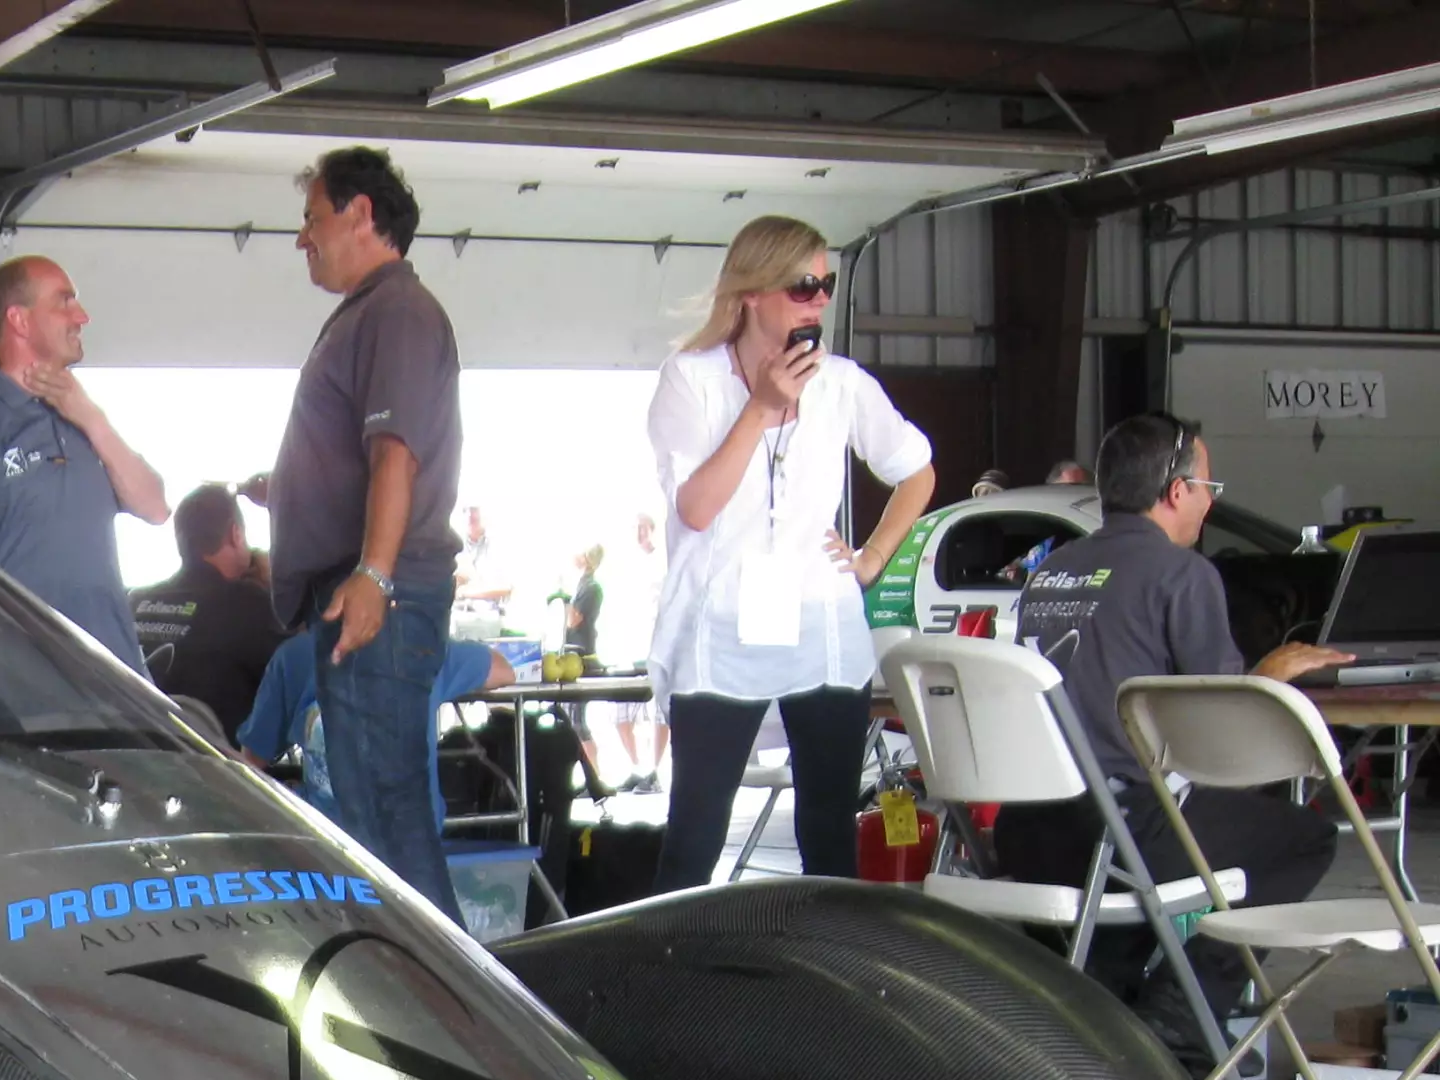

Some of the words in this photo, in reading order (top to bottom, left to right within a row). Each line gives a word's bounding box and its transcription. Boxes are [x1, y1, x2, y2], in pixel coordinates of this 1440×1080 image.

[1266, 380, 1378, 408] MOREY
[1029, 568, 1112, 589] Edison2
[7, 870, 383, 942] PROGRESSIVE
